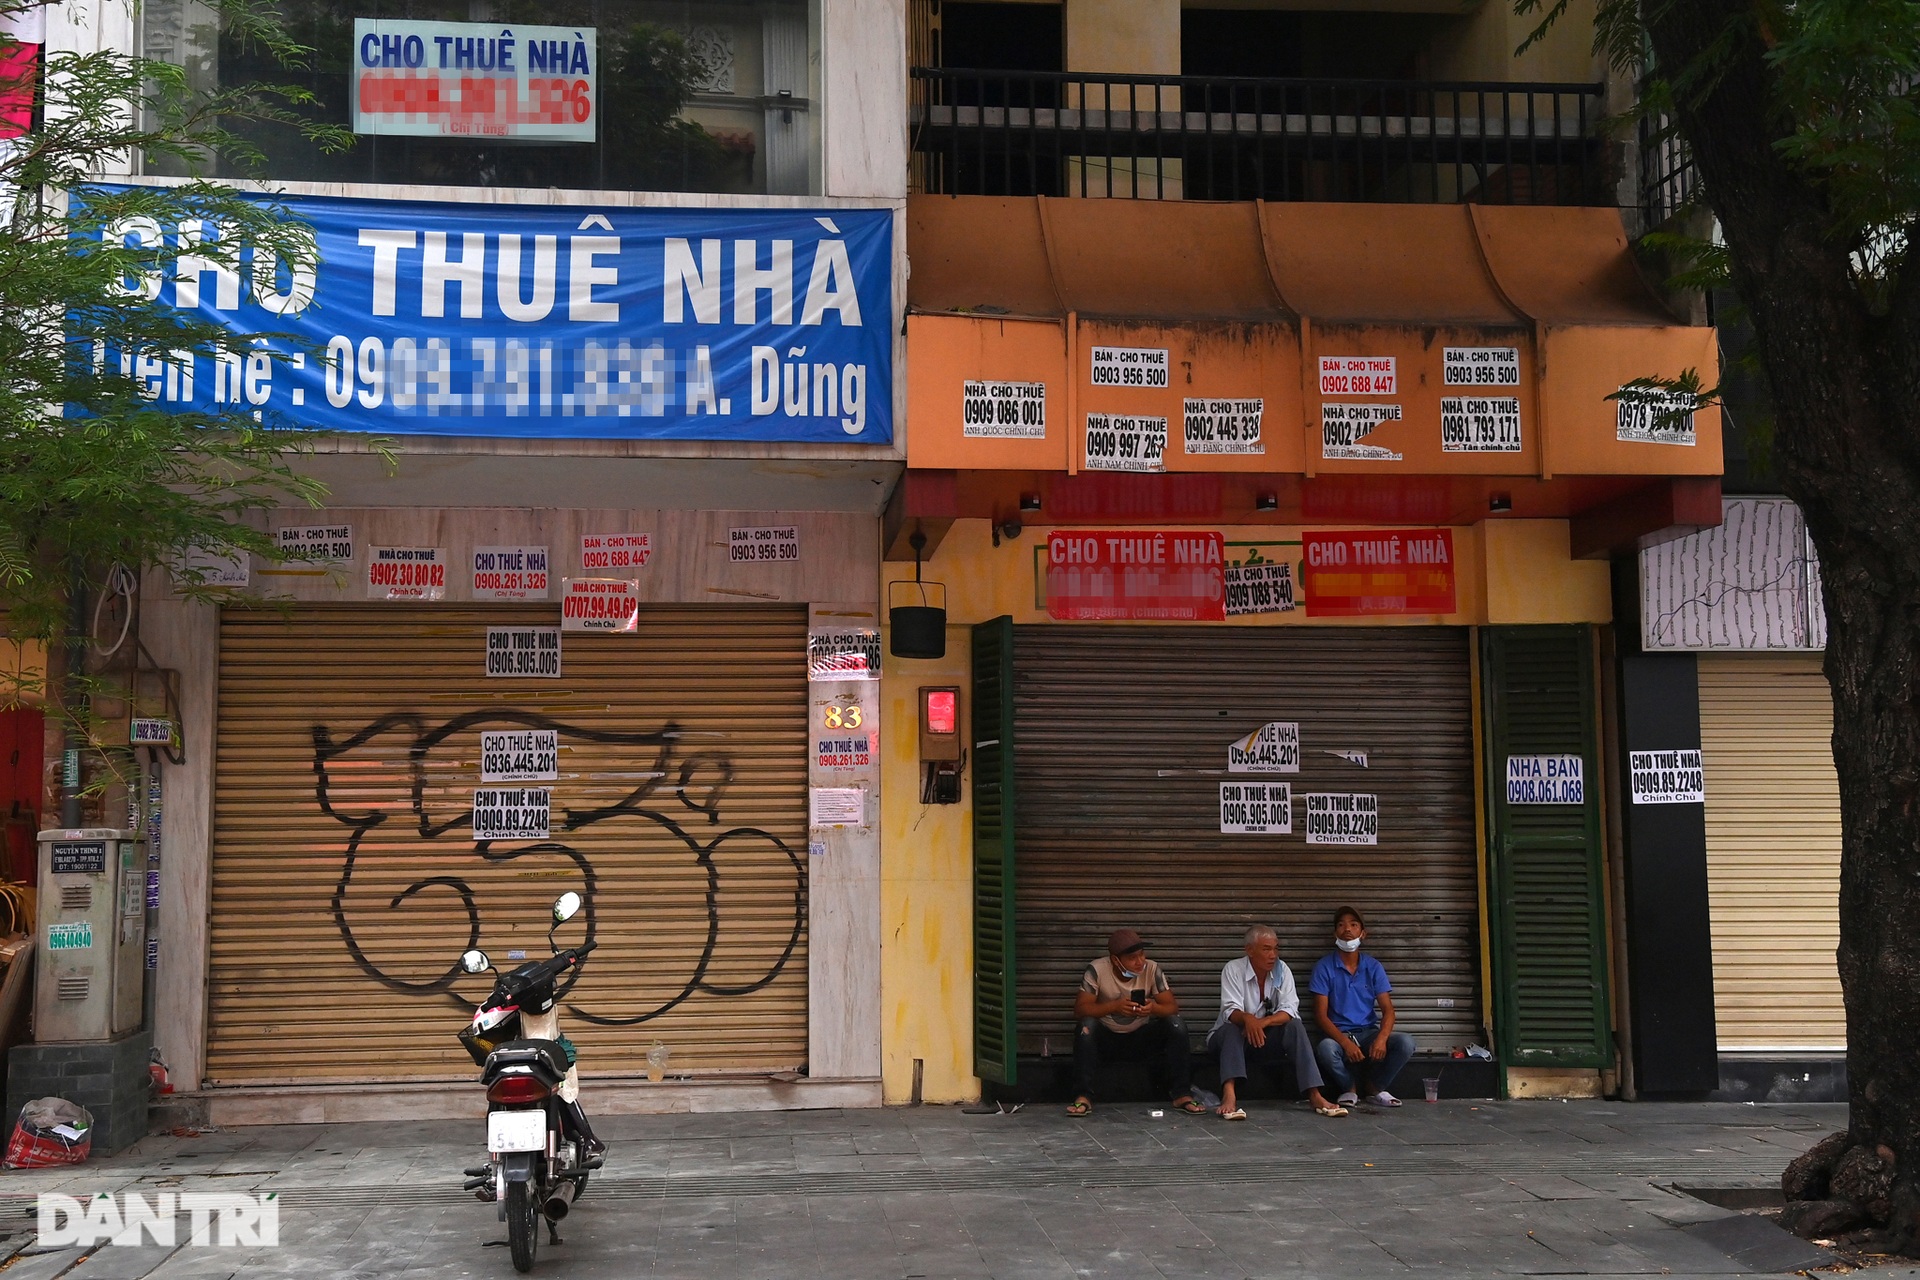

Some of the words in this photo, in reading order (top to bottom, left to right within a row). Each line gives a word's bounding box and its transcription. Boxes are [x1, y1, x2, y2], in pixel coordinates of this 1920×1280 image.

[360, 33, 424, 68] CHO
[434, 29, 515, 72] THUÊ
[528, 32, 590, 75] NHÀ
[102, 214, 317, 314] CHO
[358, 214, 621, 323] THUÊ
[663, 217, 863, 326] NHÀ
[1094, 349, 1113, 362] BÁN
[1120, 352, 1138, 363] CHO
[1140, 351, 1164, 364] THUÊ
[1323, 359, 1340, 371] BÁN
[1347, 361, 1366, 371] CHO
[1367, 359, 1391, 371] THUÊ
[1447, 349, 1464, 362] BÁN
[1471, 352, 1489, 362] CHO
[1491, 349, 1514, 362] THUÊ
[1093, 366, 1120, 384] 0903
[1123, 367, 1143, 385] 956
[1146, 368, 1166, 386] 500
[1322, 375, 1348, 393] 0902
[1351, 375, 1371, 393] 688
[1374, 375, 1394, 392] 447
[1446, 366, 1472, 383] 0903
[1475, 366, 1495, 383] 956
[1498, 366, 1517, 383] 500
[751, 345, 867, 436] Dũng
[964, 382, 987, 397] NHÀ
[991, 386, 1013, 398] CHO
[1015, 384, 1045, 399] THUÊ
[965, 399, 994, 425] 0909
[997, 400, 1019, 425] 086
[1022, 400, 1043, 426] 001
[1185, 399, 1207, 413] NHÀ
[1210, 402, 1232, 414] CHO
[1323, 405, 1345, 419] NHÀ
[1348, 407, 1370, 419] CHO
[1373, 406, 1401, 420] THUÊ
[1442, 397, 1463, 414] NHÀ
[1467, 401, 1488, 414] CHO
[1490, 397, 1518, 414] THUÊ
[1088, 415, 1109, 430] NHÀ
[1114, 418, 1135, 431] CHO
[1138, 418, 1166, 432] THUÊ
[1619, 403, 1646, 429] 0978
[1185, 416, 1214, 441] 0902
[1217, 416, 1238, 441] 445
[1323, 421, 1351, 446] 0902
[1443, 415, 1471, 442] 0981
[1474, 415, 1495, 442] 793
[1499, 416, 1519, 442] 171
[1087, 431, 1116, 457] 0909
[1119, 433, 1140, 458] 997
[282, 528, 300, 540] BÁN
[306, 530, 324, 540] CHO
[326, 526, 349, 539] THUÊ
[584, 536, 601, 548] BÁN
[607, 538, 624, 548] CHO
[626, 534, 648, 546] THUÊ
[732, 530, 748, 541] BÁN
[754, 530, 772, 540] CHO
[774, 527, 795, 539] THUÊ
[332, 542, 351, 558] 500
[379, 548, 396, 560] NHÀ
[396, 550, 413, 560] CHO
[414, 549, 435, 561] THUÊ
[731, 544, 756, 561] 0903
[758, 544, 777, 560] 956
[779, 543, 797, 559] 500
[1051, 537, 1099, 564] CHO
[1106, 533, 1166, 564] THUÊ
[1174, 533, 1221, 564] NHÀ
[1308, 541, 1348, 567] CHO
[1352, 536, 1401, 565] THUÊ
[1407, 535, 1449, 564] NHÀ
[475, 552, 495, 571] CHO
[497, 549, 523, 571] THUÊ
[526, 549, 546, 571] NHÀ
[583, 552, 609, 568] 0902
[611, 551, 629, 567] 688
[632, 550, 651, 566] 447
[370, 562, 398, 586] 0902
[399, 563, 413, 586] 30
[414, 564, 428, 586] 80
[430, 563, 444, 587] 82
[1244, 567, 1263, 580] CHO
[1265, 562, 1290, 579] THUÊ
[475, 573, 546, 590] 0908.261.326
[572, 581, 589, 593] NHÀ
[590, 583, 606, 593] CHO
[607, 581, 628, 594] THUÊ
[1225, 583, 1249, 608] 0909
[1251, 581, 1271, 606] 088
[1273, 579, 1293, 604] 540
[563, 595, 637, 620] 0707.99.49.69
[489, 632, 509, 649] CHO
[512, 629, 536, 649] THUÊ
[538, 630, 558, 649] NHÀ
[834, 635, 853, 644] CHO
[856, 632, 880, 644] THUÊ
[488, 651, 558, 674] 0906.905.006
[824, 705, 863, 729] 83
[484, 736, 505, 752] CHO
[507, 732, 533, 751] THUÊ
[535, 731, 555, 751] NHÀ
[1278, 724, 1297, 743] NHÀ
[819, 741, 833, 753] CHO
[834, 737, 852, 752] THUÊ
[854, 737, 868, 752] NHÀ
[484, 753, 556, 774] 0936.445.201
[819, 753, 869, 767] 0908.261.326
[1510, 754, 1542, 777] NHÀ
[1547, 753, 1579, 777] BÁN
[1632, 754, 1652, 770] CHO
[1654, 751, 1679, 769] THUÊ
[1681, 750, 1701, 768] NHÀ
[1223, 786, 1241, 801] CHO
[1244, 784, 1266, 801] THUÊ
[1269, 785, 1287, 801] NHÀ
[1508, 779, 1582, 803] 0908.061.068
[1633, 771, 1702, 794] 0909.89.2248
[475, 791, 497, 807] CHO
[500, 788, 525, 807] THUÊ
[527, 788, 548, 807] NHÀ
[1308, 796, 1328, 811] CHO
[1330, 794, 1355, 811] THUÊ
[1356, 794, 1376, 812] NHÀ
[475, 809, 548, 831] 0909.89.2248
[1223, 803, 1288, 825] 0906.905.006
[1308, 813, 1377, 835] 0909.89.2248
